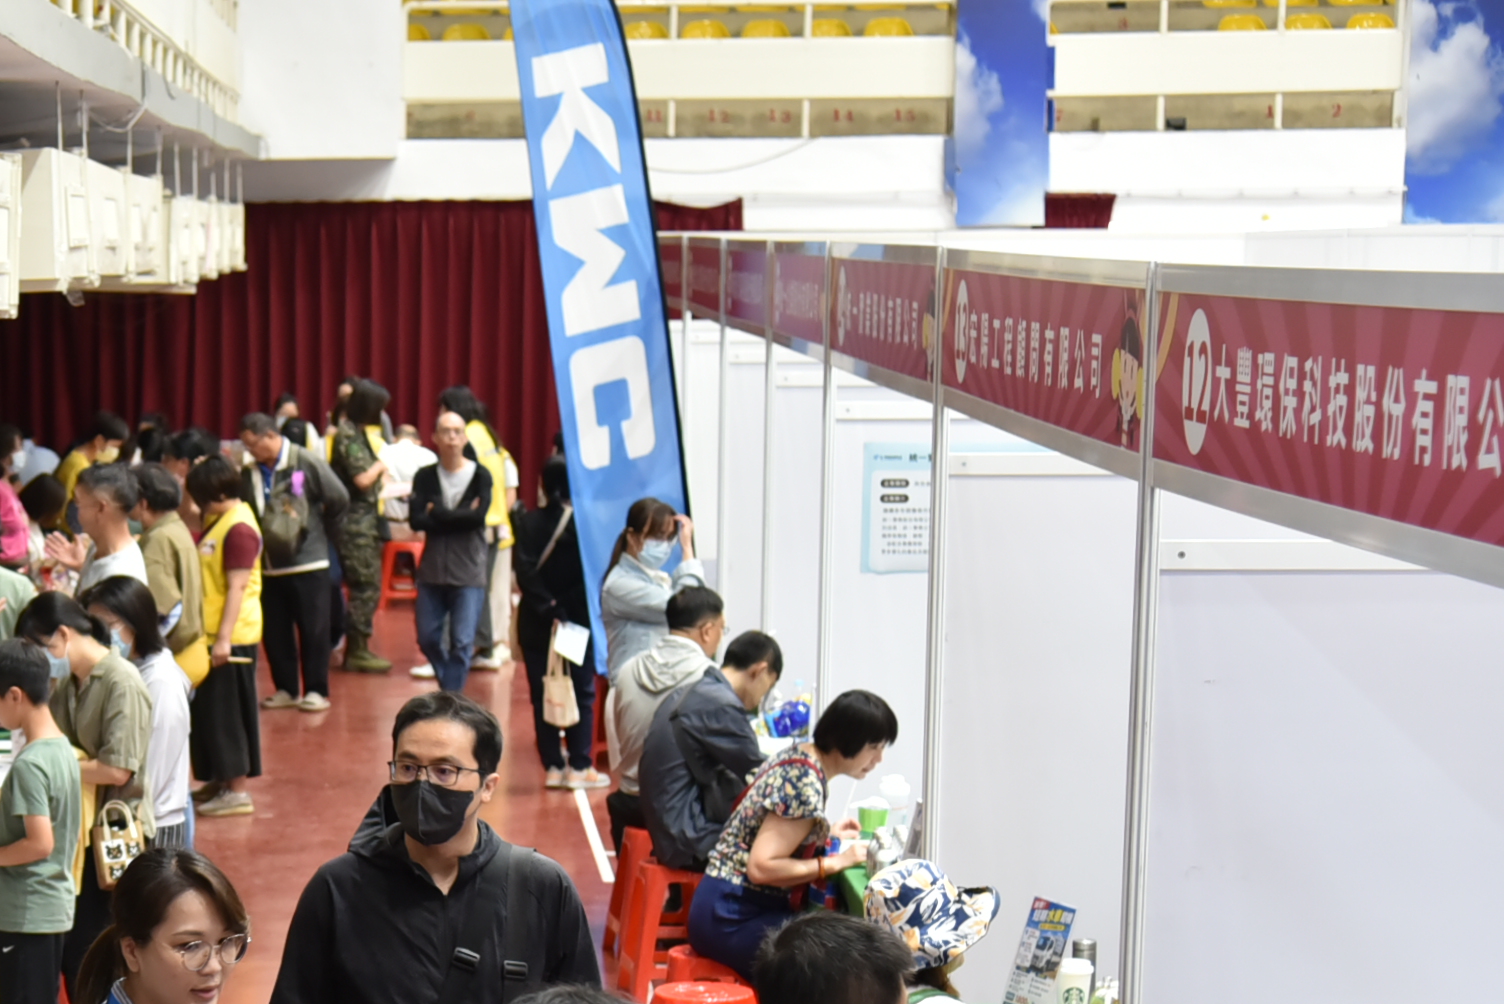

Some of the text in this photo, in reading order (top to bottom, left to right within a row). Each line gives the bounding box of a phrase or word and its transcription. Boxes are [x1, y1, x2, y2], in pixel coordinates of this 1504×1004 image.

[531, 42, 656, 470] KMC
[1183, 339, 1504, 479] 12 大豐環保科技股份有限公
